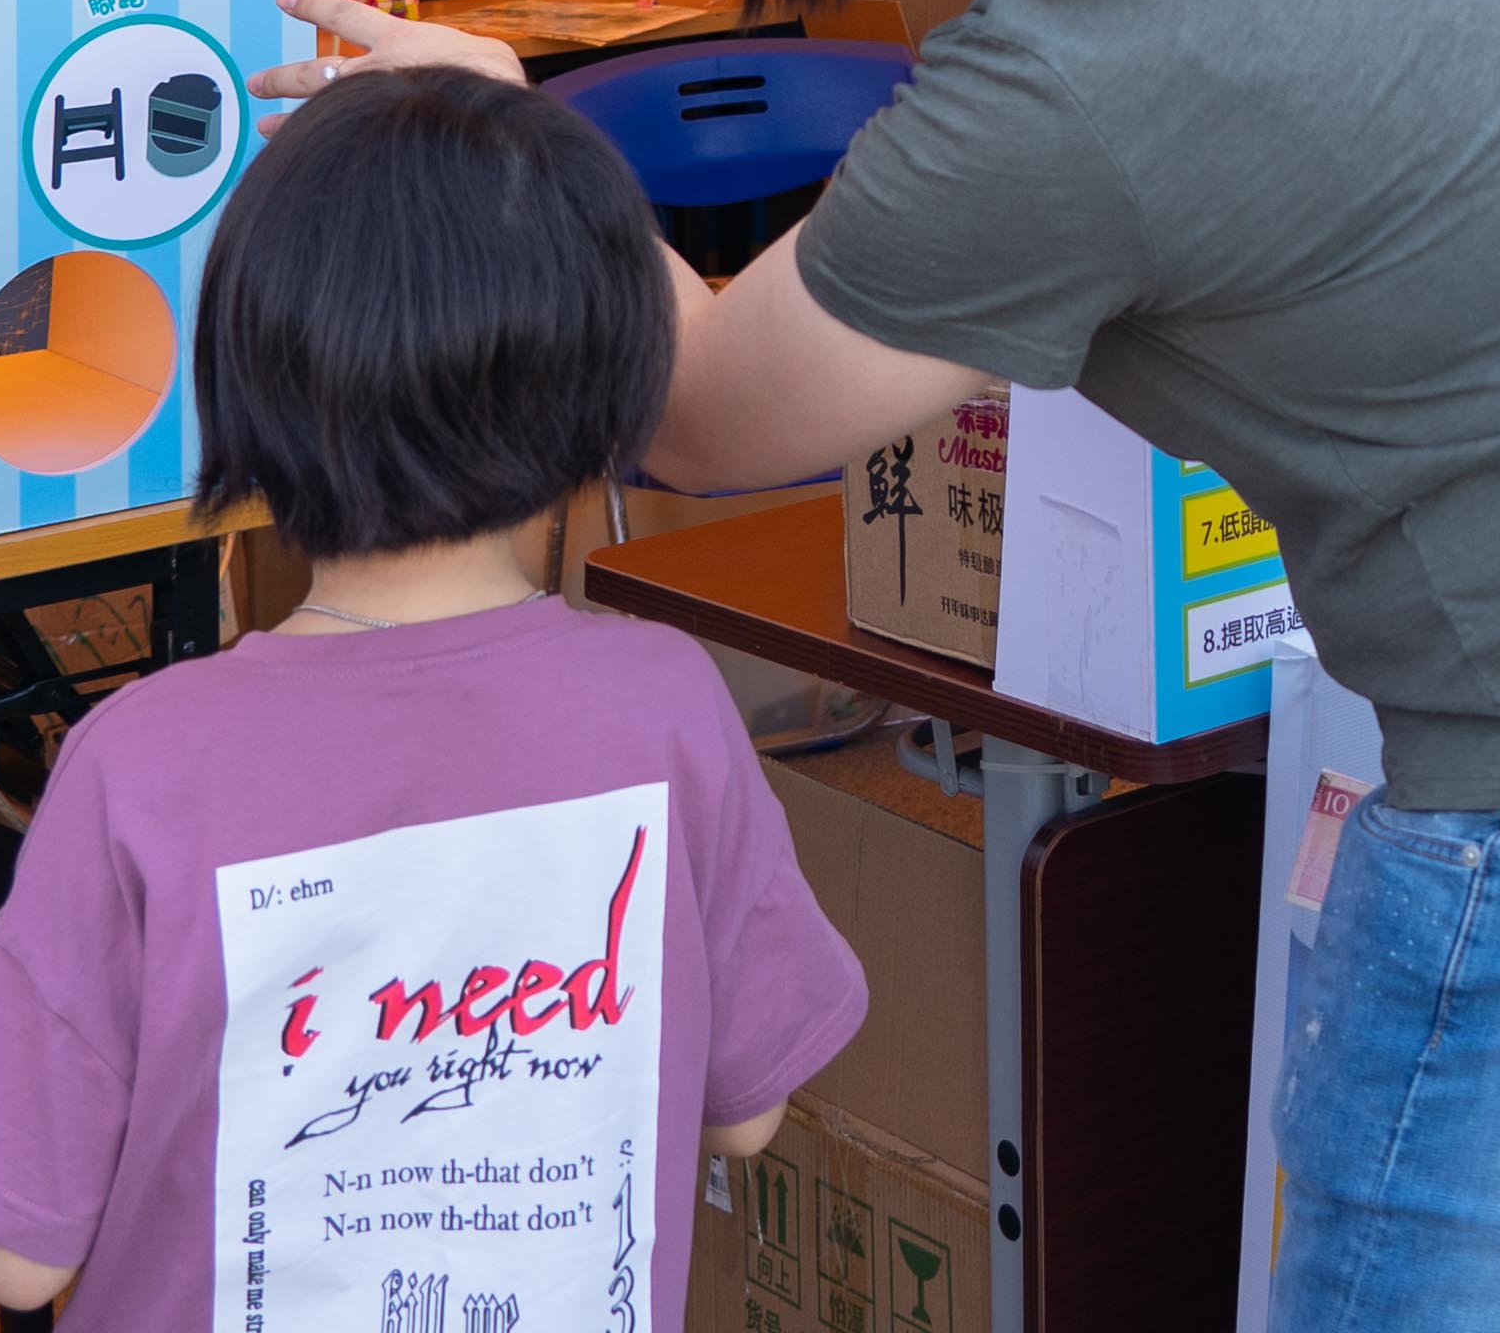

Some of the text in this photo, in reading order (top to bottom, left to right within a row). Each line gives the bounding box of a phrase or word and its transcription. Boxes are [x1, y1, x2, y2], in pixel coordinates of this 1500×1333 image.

[862, 435, 924, 608] 鮮
[1322, 790, 1352, 815] 10
[368, 823, 648, 1045] need
[285, 1023, 603, 1150] you right now
[380, 1163, 435, 1189] now
[441, 1156, 520, 1184] th-that
[242, 1178, 272, 1333] can only make me str
[380, 1209, 434, 1230] now
[441, 1203, 519, 1231] th-that
[757, 1250, 792, 1295] 向上
